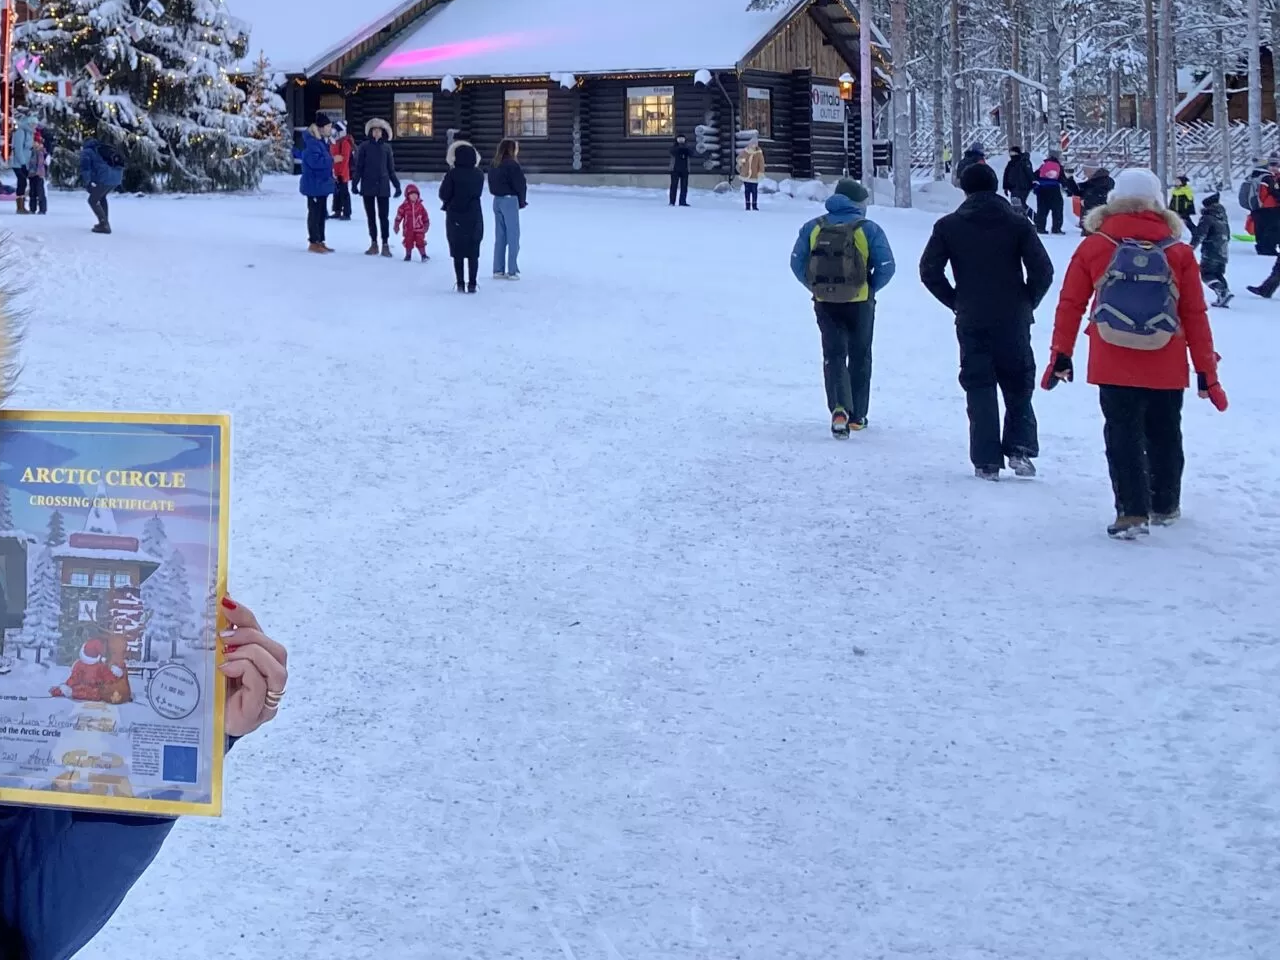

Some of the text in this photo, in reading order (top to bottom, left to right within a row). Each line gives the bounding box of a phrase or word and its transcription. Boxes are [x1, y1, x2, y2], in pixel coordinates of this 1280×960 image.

[20, 467, 186, 488] ARCTIC CIRCLE
[29, 495, 175, 512] CROSSING CERTIFICATE
[8, 726, 19, 735] the
[20, 727, 40, 737] Arctic
[42, 728, 61, 738] Circle
